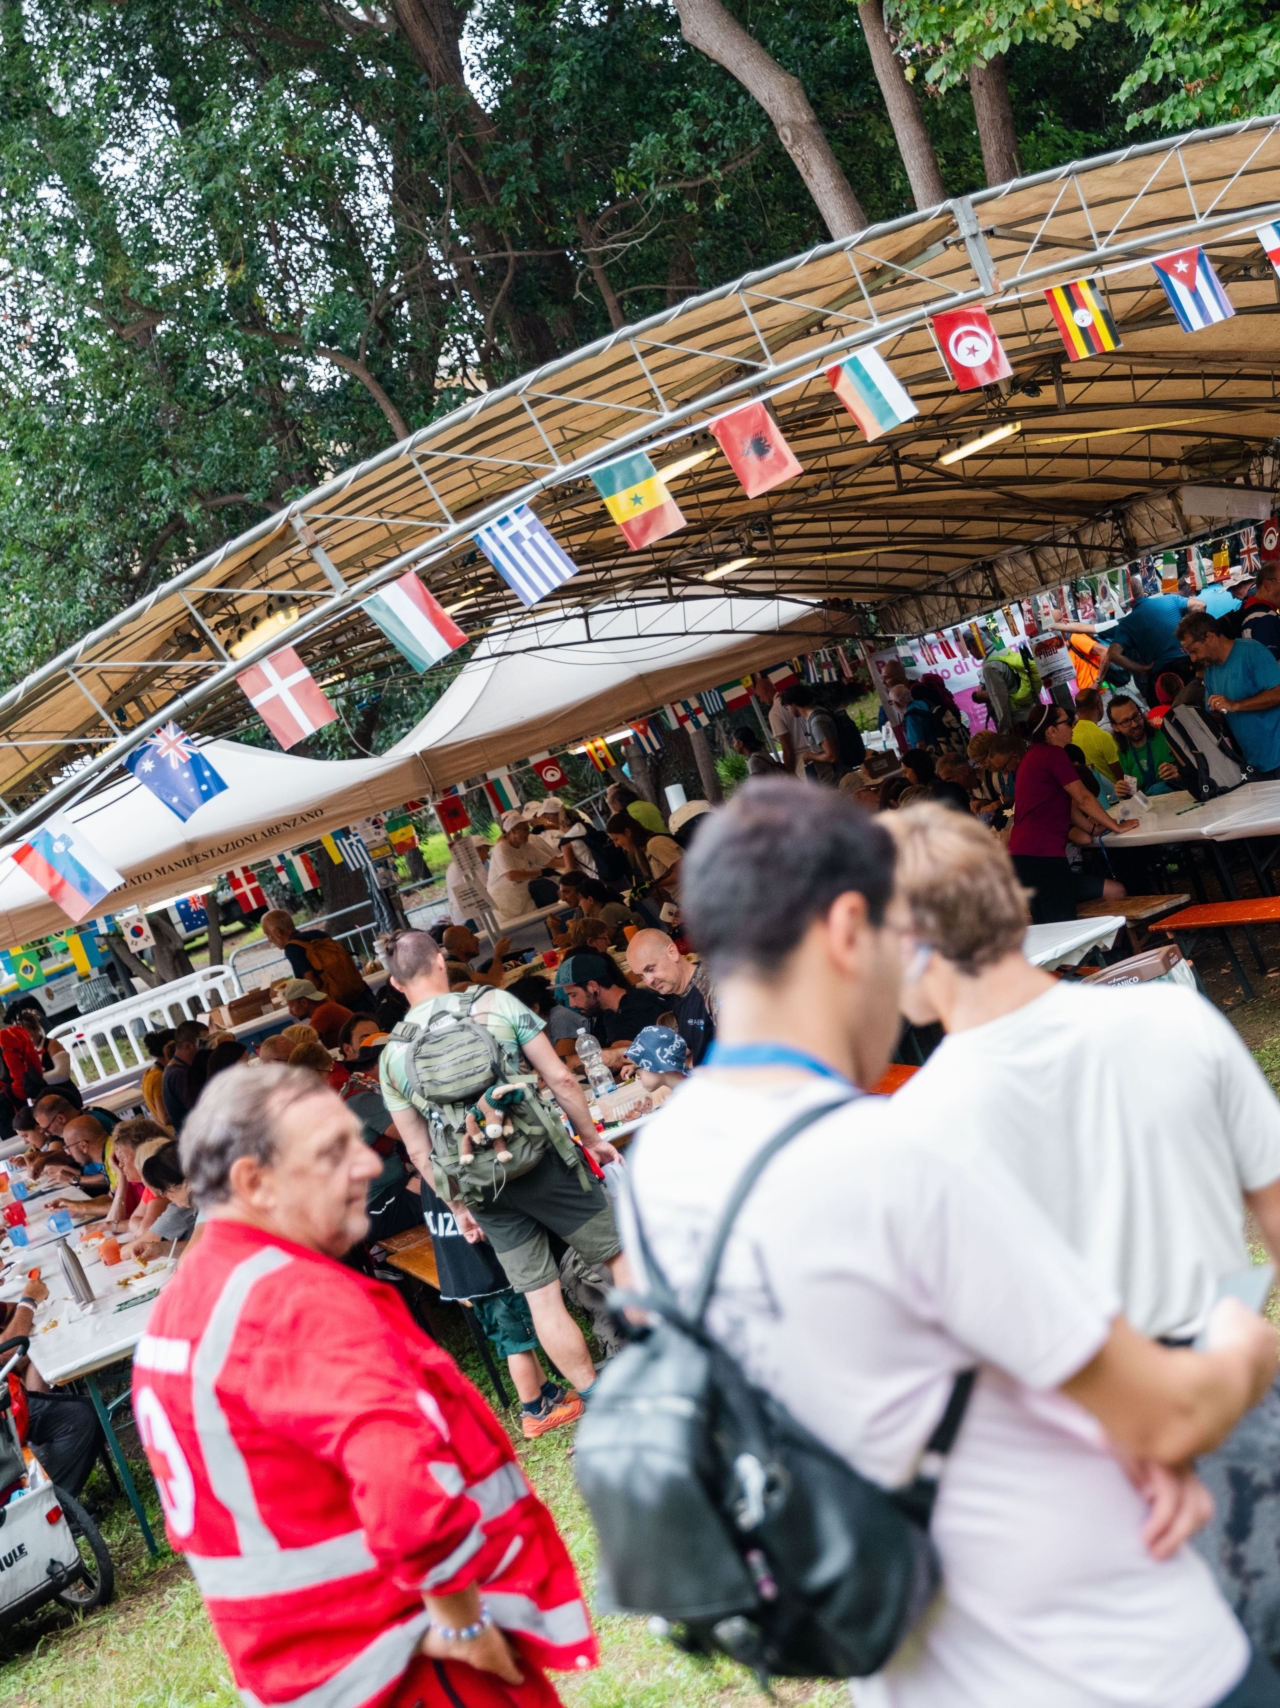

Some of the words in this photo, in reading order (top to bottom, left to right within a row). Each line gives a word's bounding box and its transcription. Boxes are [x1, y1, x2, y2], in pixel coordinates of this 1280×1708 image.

[953, 659, 970, 675] di
[155, 834, 257, 878] MANIFESTAZIONI
[260, 808, 324, 840] ARENZANO
